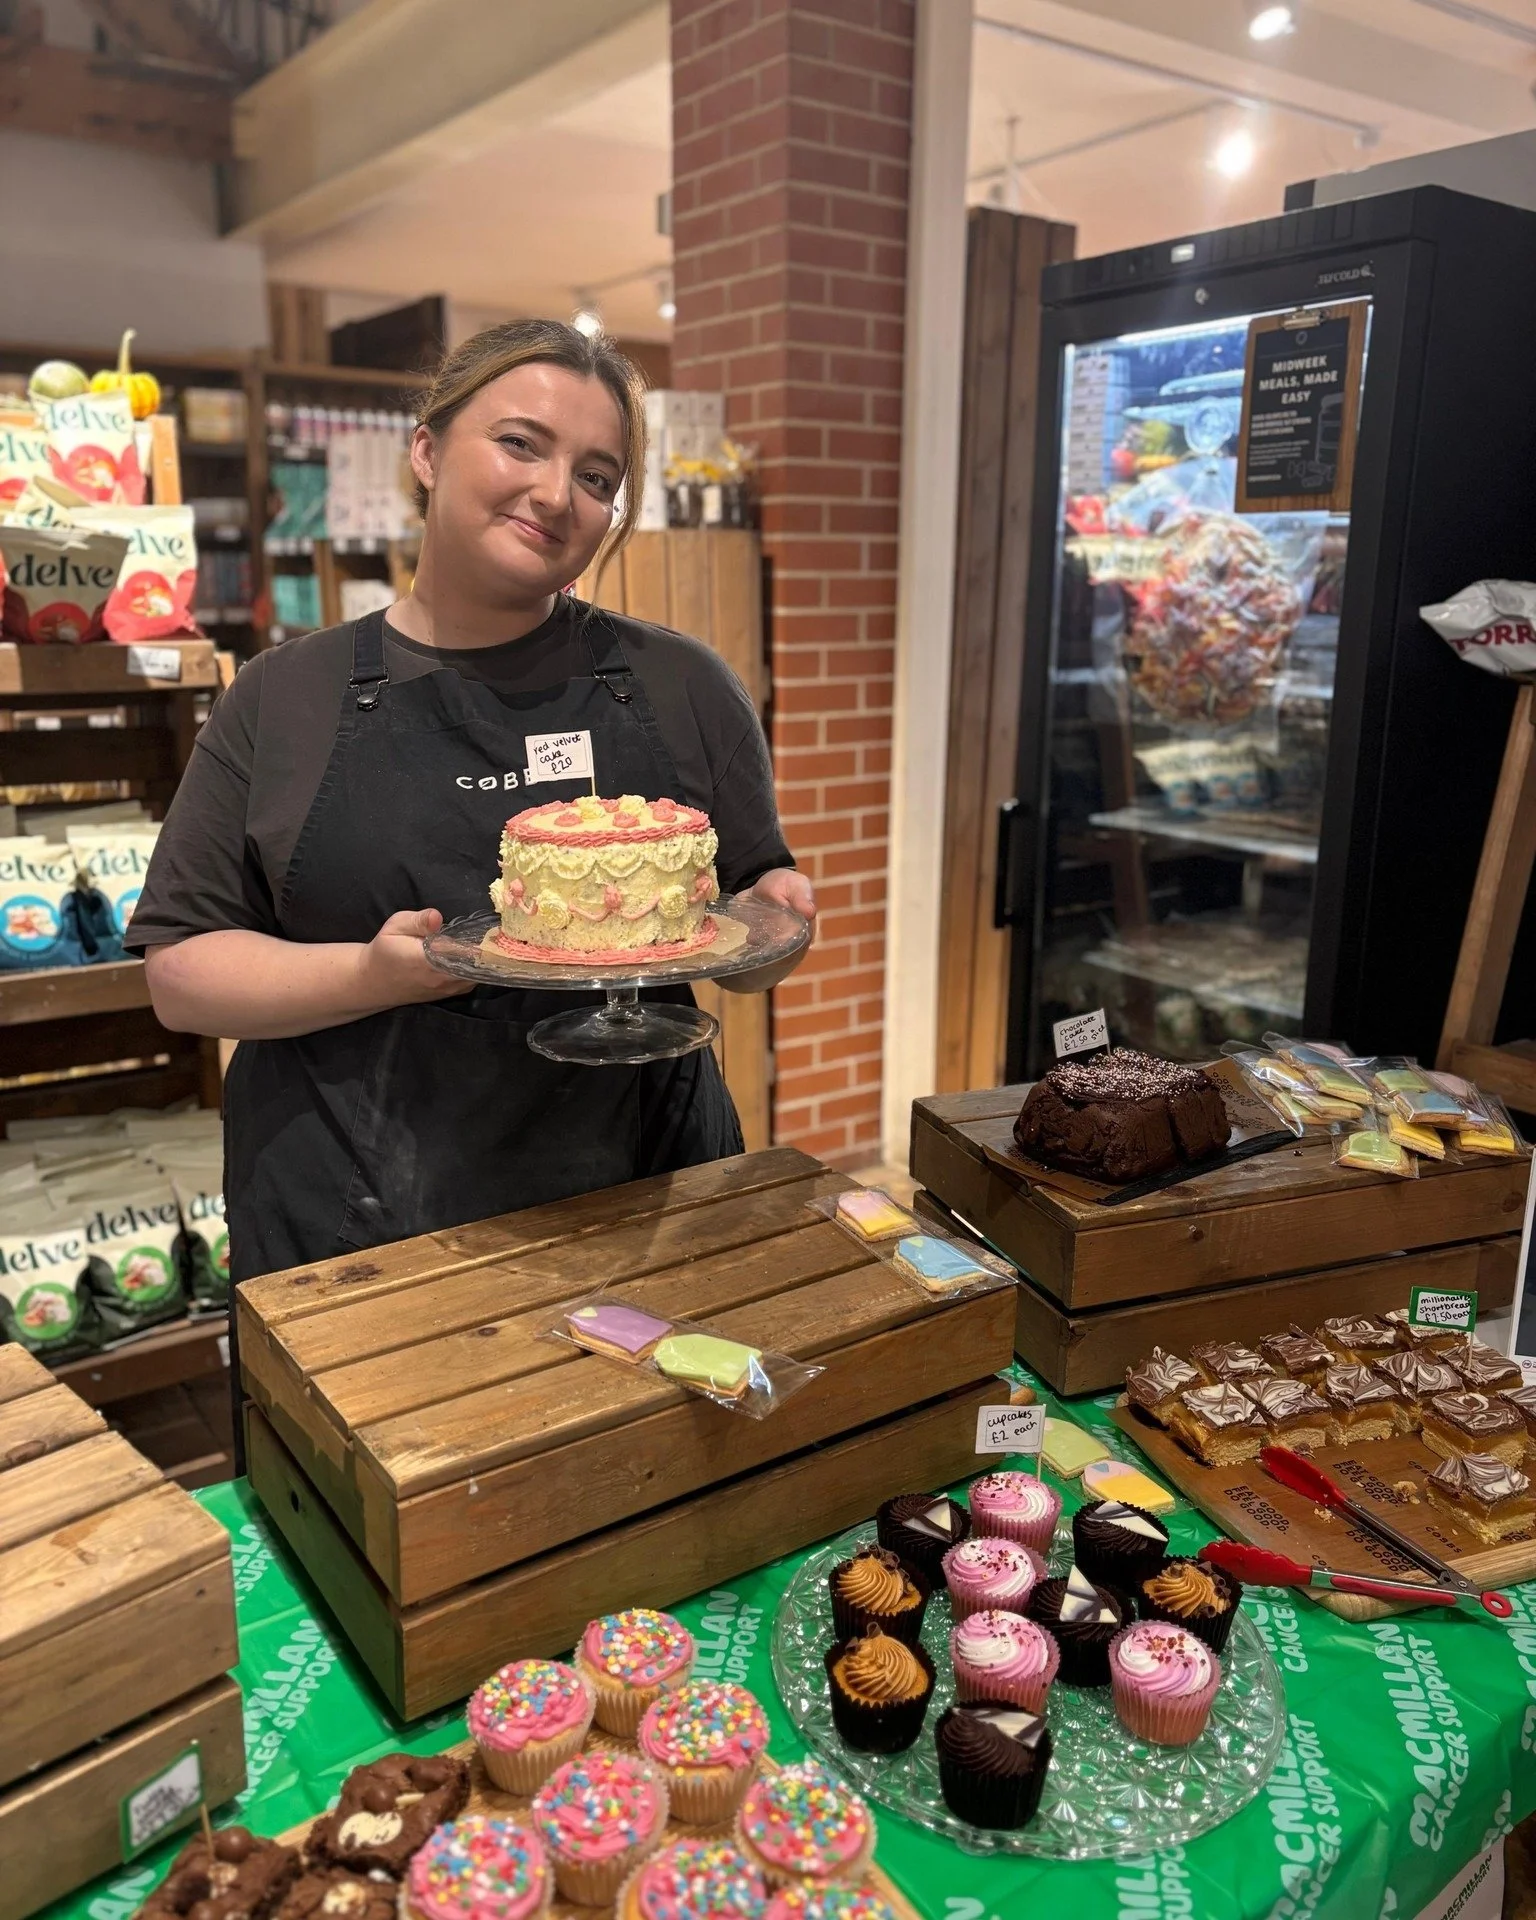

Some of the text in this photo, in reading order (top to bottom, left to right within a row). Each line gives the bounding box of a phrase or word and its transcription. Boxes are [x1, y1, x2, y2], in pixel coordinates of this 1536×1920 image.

[1272, 355, 1327, 373] MIDWEEK
[1303, 370, 1338, 386] MADE
[1281, 390, 1311, 405] EASY
[10, 553, 115, 589] delve
[533, 733, 581, 755] red velvet
[539, 749, 564, 764] cake
[550, 756, 573, 775] £20
[0, 854, 66, 882] elve
[1060, 1015, 1096, 1036] chocolate
[1064, 1027, 1085, 1042] cake
[85, 1206, 177, 1244] delve
[987, 1410, 1033, 1427] cupcakes
[991, 1421, 1038, 1444] £2 each
[1332, 1463, 1349, 1476] DO
[1223, 1489, 1240, 1502] DO
[1231, 1487, 1255, 1507] FEEL
[1240, 1485, 1260, 1500] EAT
[1345, 1530, 1364, 1543] DO
[722, 1603, 764, 1684] UPPORT
[1367, 1623, 1448, 1847] MACMILLAN
[1408, 1633, 1470, 1852] CANCER SUPPORT
[1289, 1713, 1341, 1817] SUPPORT
